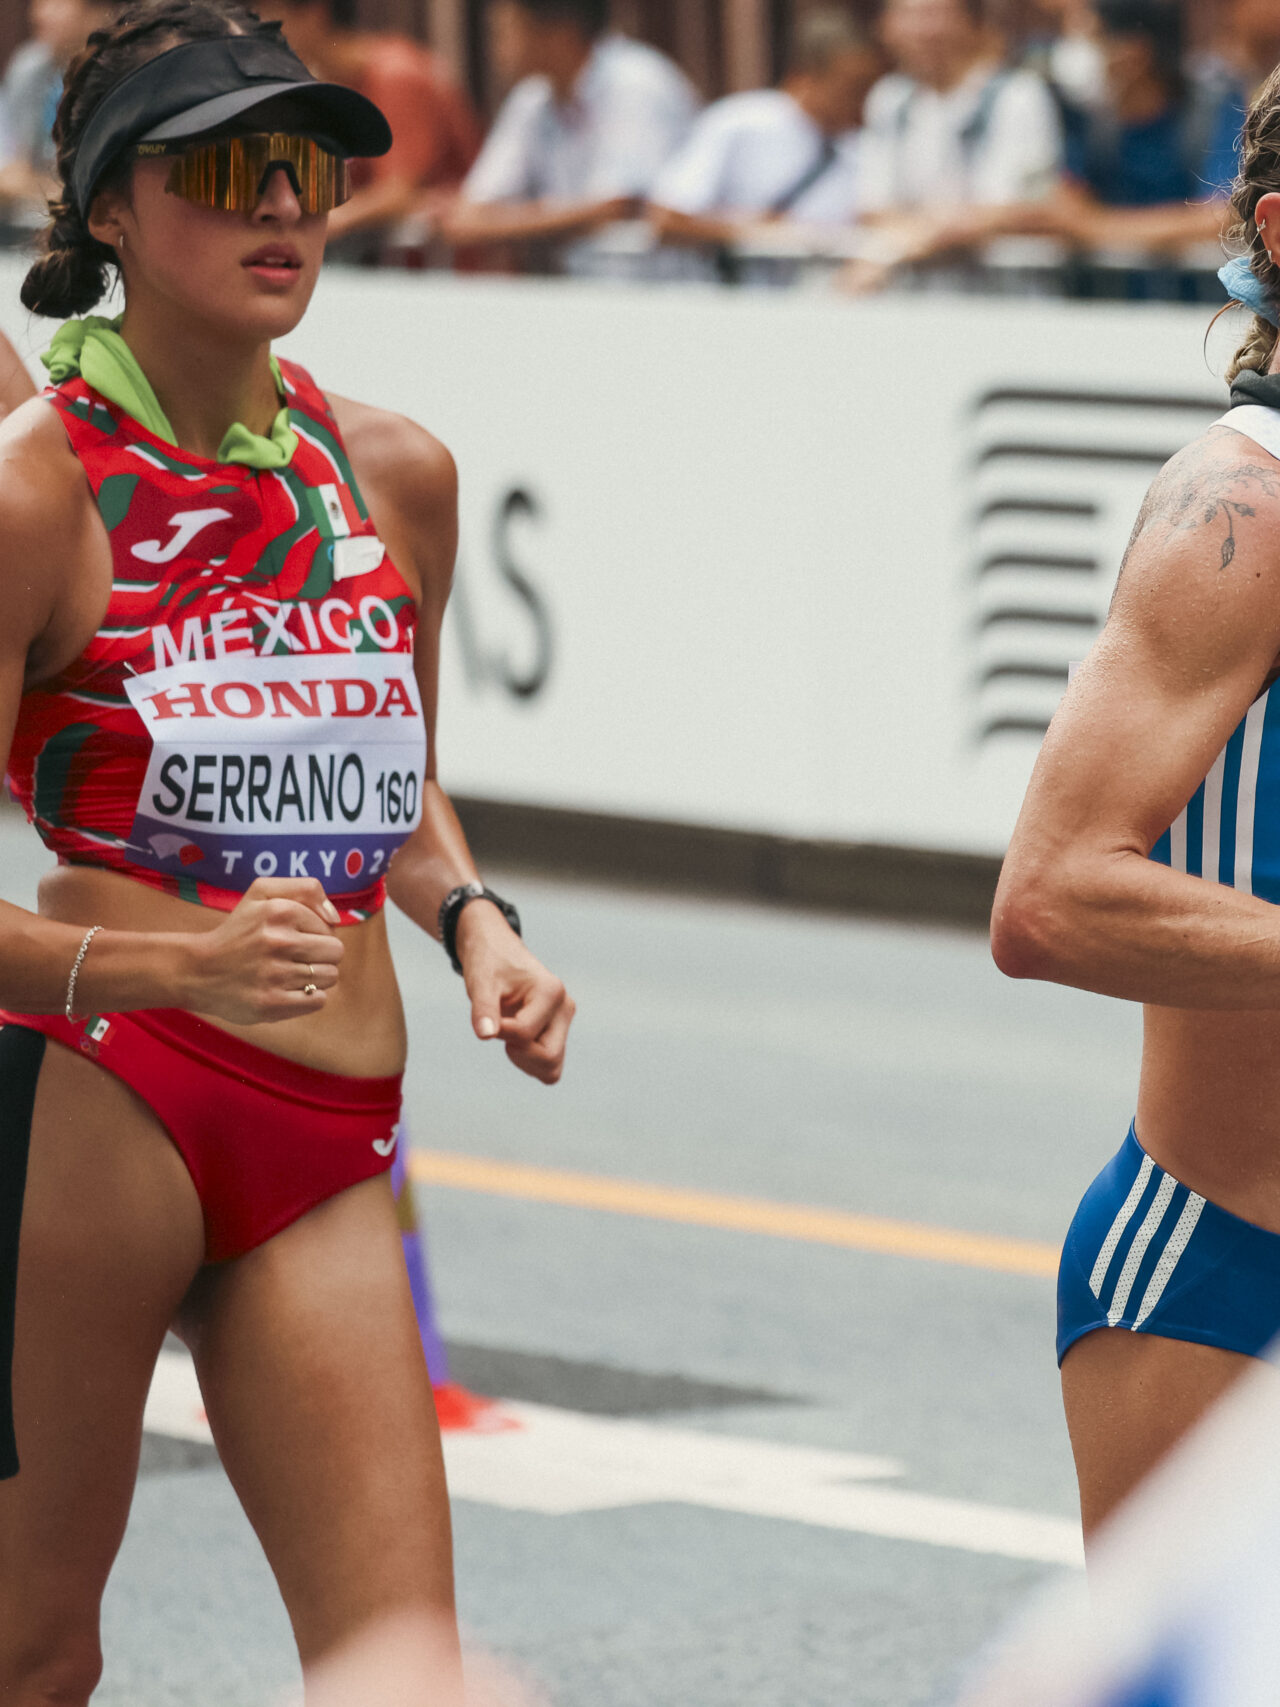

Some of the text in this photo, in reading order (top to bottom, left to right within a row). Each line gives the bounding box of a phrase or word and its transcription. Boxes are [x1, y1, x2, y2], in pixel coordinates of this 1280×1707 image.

[151, 595, 399, 671] MÉXICO
[142, 678, 418, 720] HONDA
[152, 752, 417, 825] SERRANO 160
